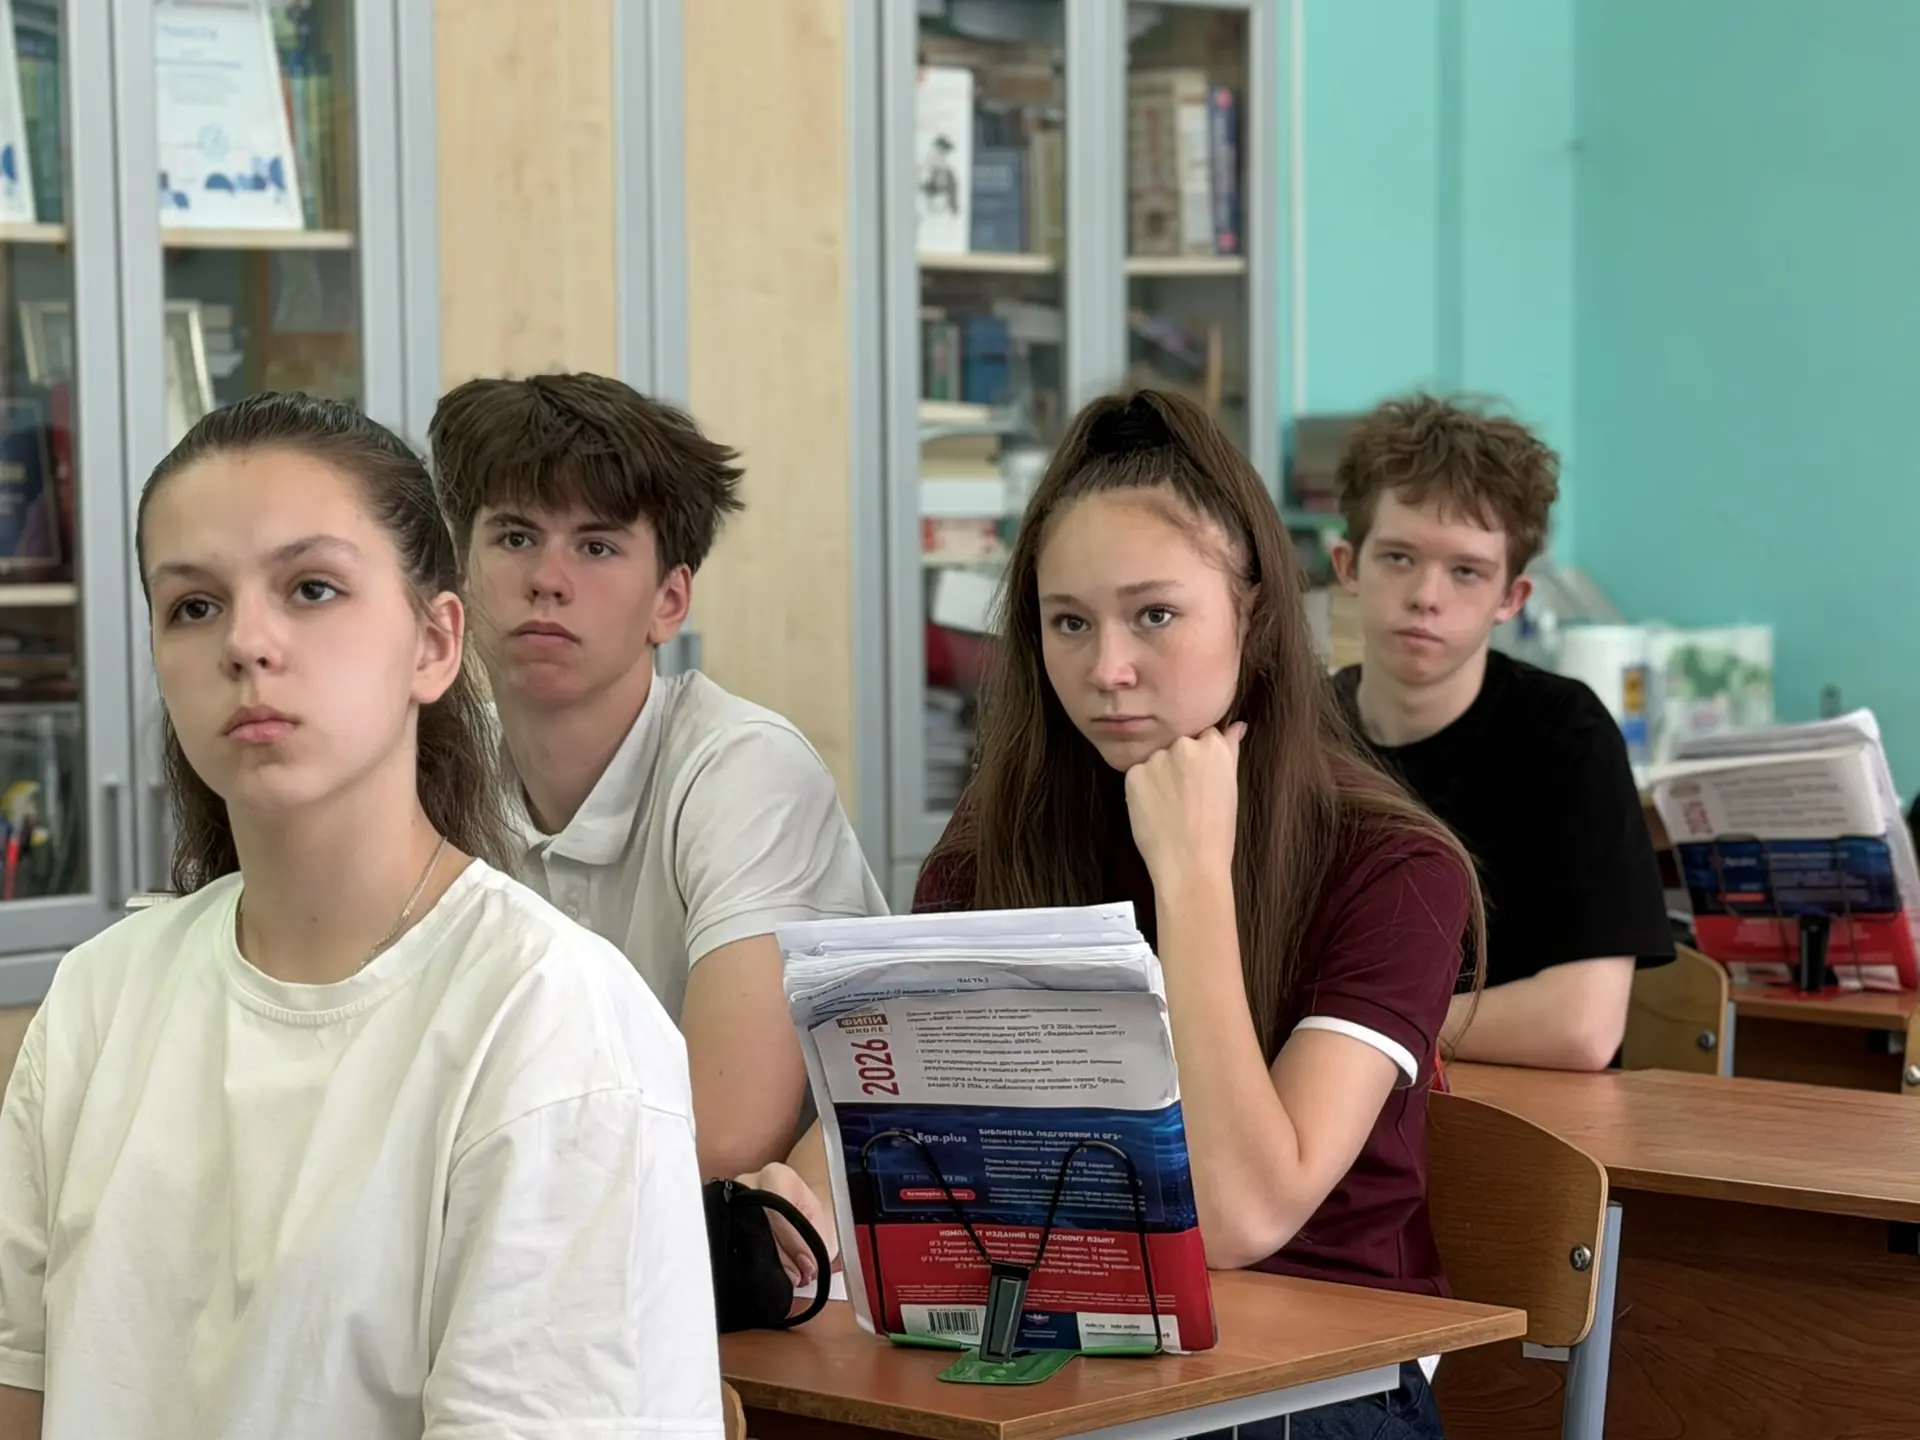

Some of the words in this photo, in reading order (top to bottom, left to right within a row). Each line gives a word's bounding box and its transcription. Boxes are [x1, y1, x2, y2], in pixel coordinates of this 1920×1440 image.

[840, 1015, 883, 1026] ФИПИ
[851, 1039, 900, 1096] 2026
[917, 1132, 968, 1144] Ege.plus
[978, 1128, 1034, 1137] БИБЛИОТЕКА
[1036, 1130, 1092, 1139] ПОДГОТОВКИ
[985, 1230, 1027, 1239] ИЗДАНИЙ
[1028, 1232, 1040, 1240] ПО
[1048, 1233, 1086, 1243] УССКОМУ
